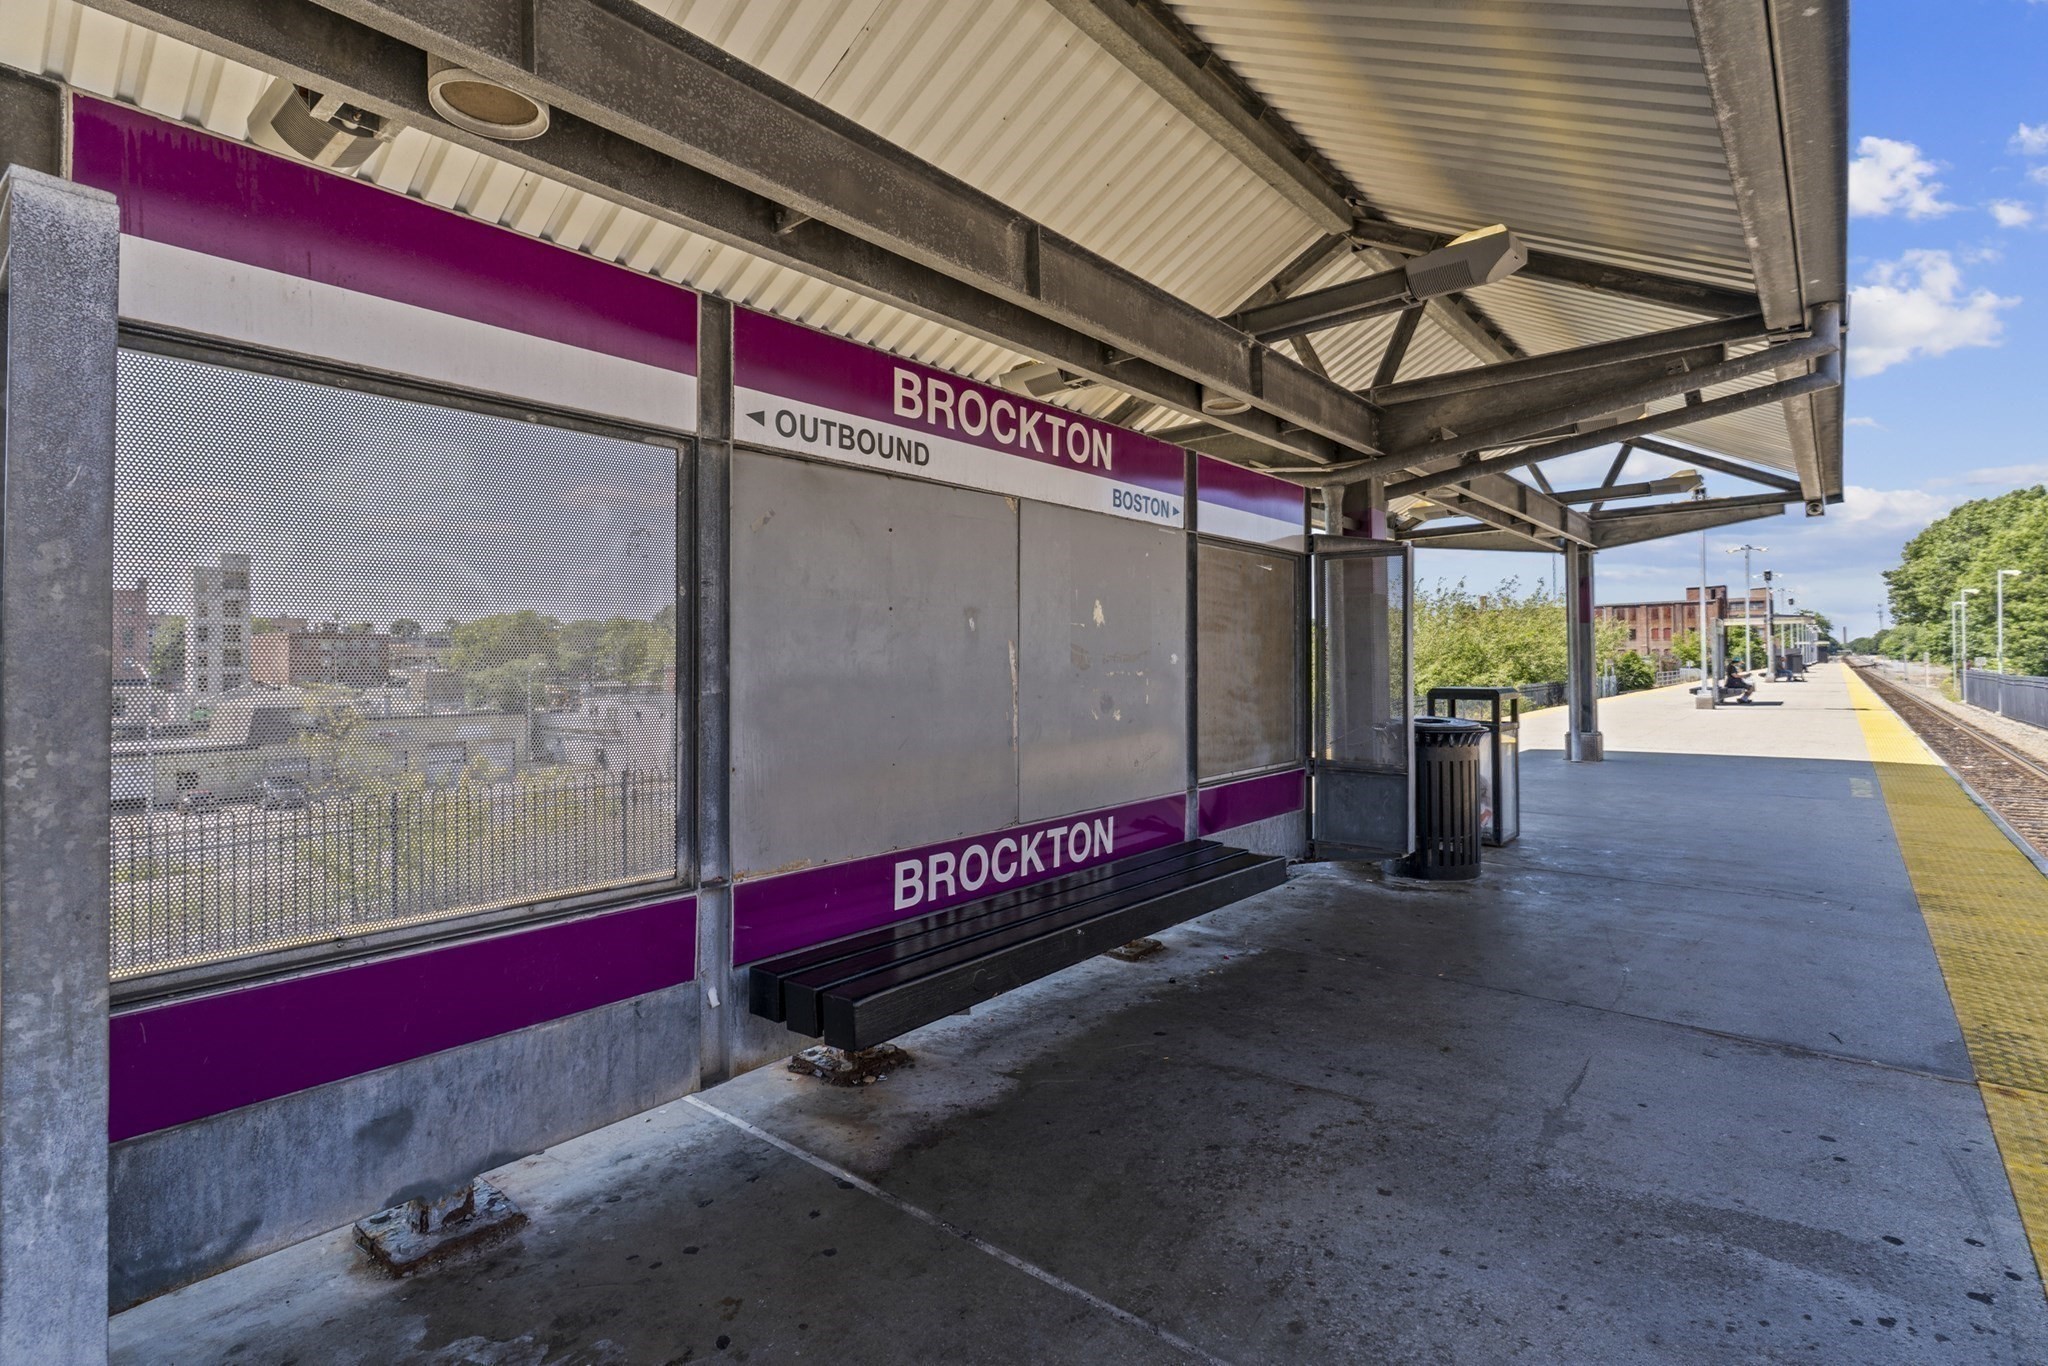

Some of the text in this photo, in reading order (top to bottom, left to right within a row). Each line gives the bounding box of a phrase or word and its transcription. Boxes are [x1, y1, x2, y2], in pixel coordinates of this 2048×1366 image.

[775, 410, 930, 466] OUTBOUND
[893, 367, 1112, 470] BROCKTON
[1112, 488, 1169, 518] BOSTON
[894, 816, 1114, 911] BROCKTON
